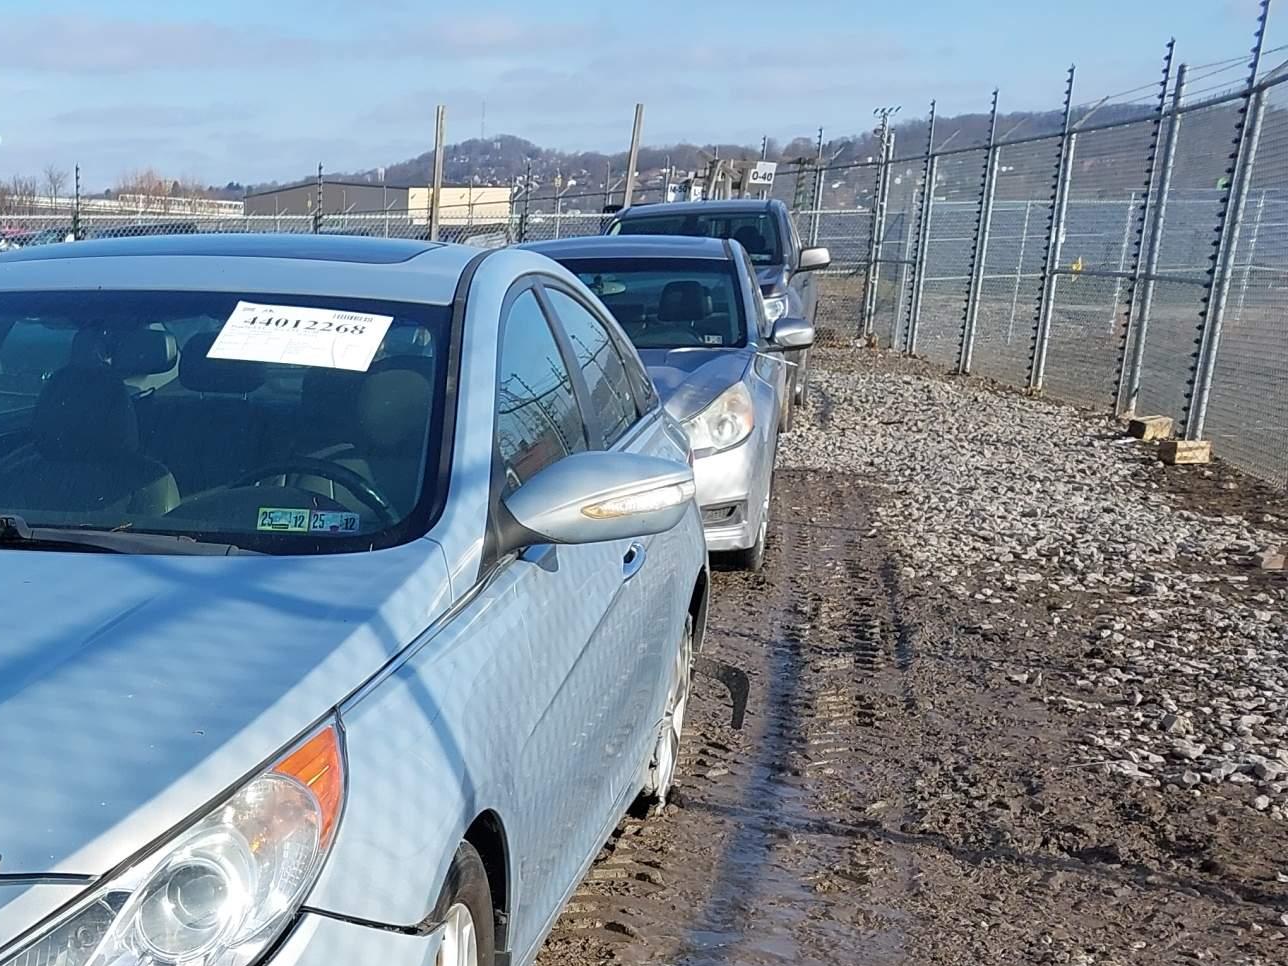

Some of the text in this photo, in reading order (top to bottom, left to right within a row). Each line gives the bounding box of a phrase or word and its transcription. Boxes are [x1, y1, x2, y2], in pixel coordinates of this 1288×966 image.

[243, 315, 367, 336] 44012268
[260, 511, 305, 529] 25 12
[312, 513, 356, 531] 25 12
